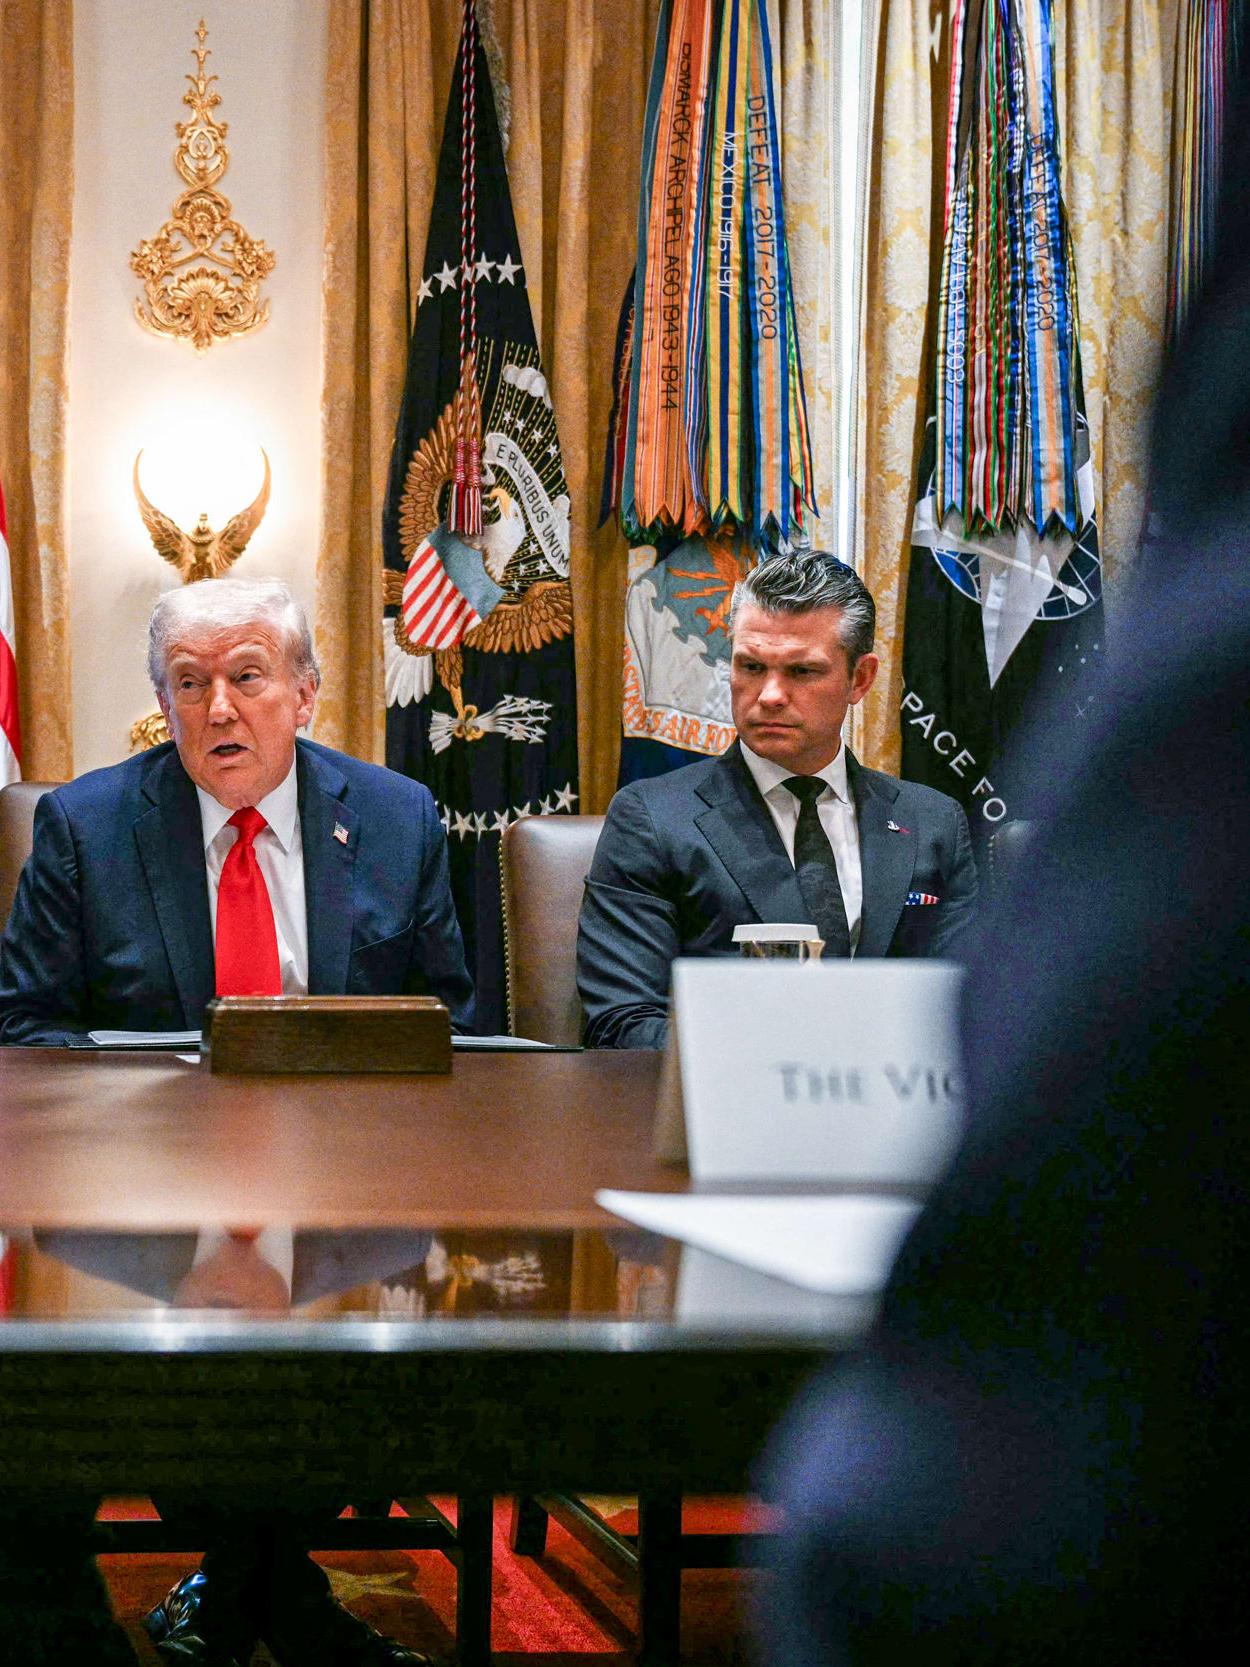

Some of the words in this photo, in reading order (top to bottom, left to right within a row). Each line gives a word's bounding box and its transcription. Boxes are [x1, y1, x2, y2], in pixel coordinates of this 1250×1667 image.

[718, 131, 739, 209] MEXICO
[748, 95, 771, 186] DEFEAT
[662, 154, 688, 297] ARCHIPELAGO
[716, 217, 735, 299] 1916-1917
[661, 304, 680, 411] 1943-1944
[495, 443, 507, 459] E
[508, 451, 549, 524] PLURIBUS
[542, 524, 570, 569] UNUM
[660, 714, 701, 747] AIR
[900, 691, 977, 778] PACE
[971, 776, 1007, 822] FO
[778, 1062, 864, 1102] THE
